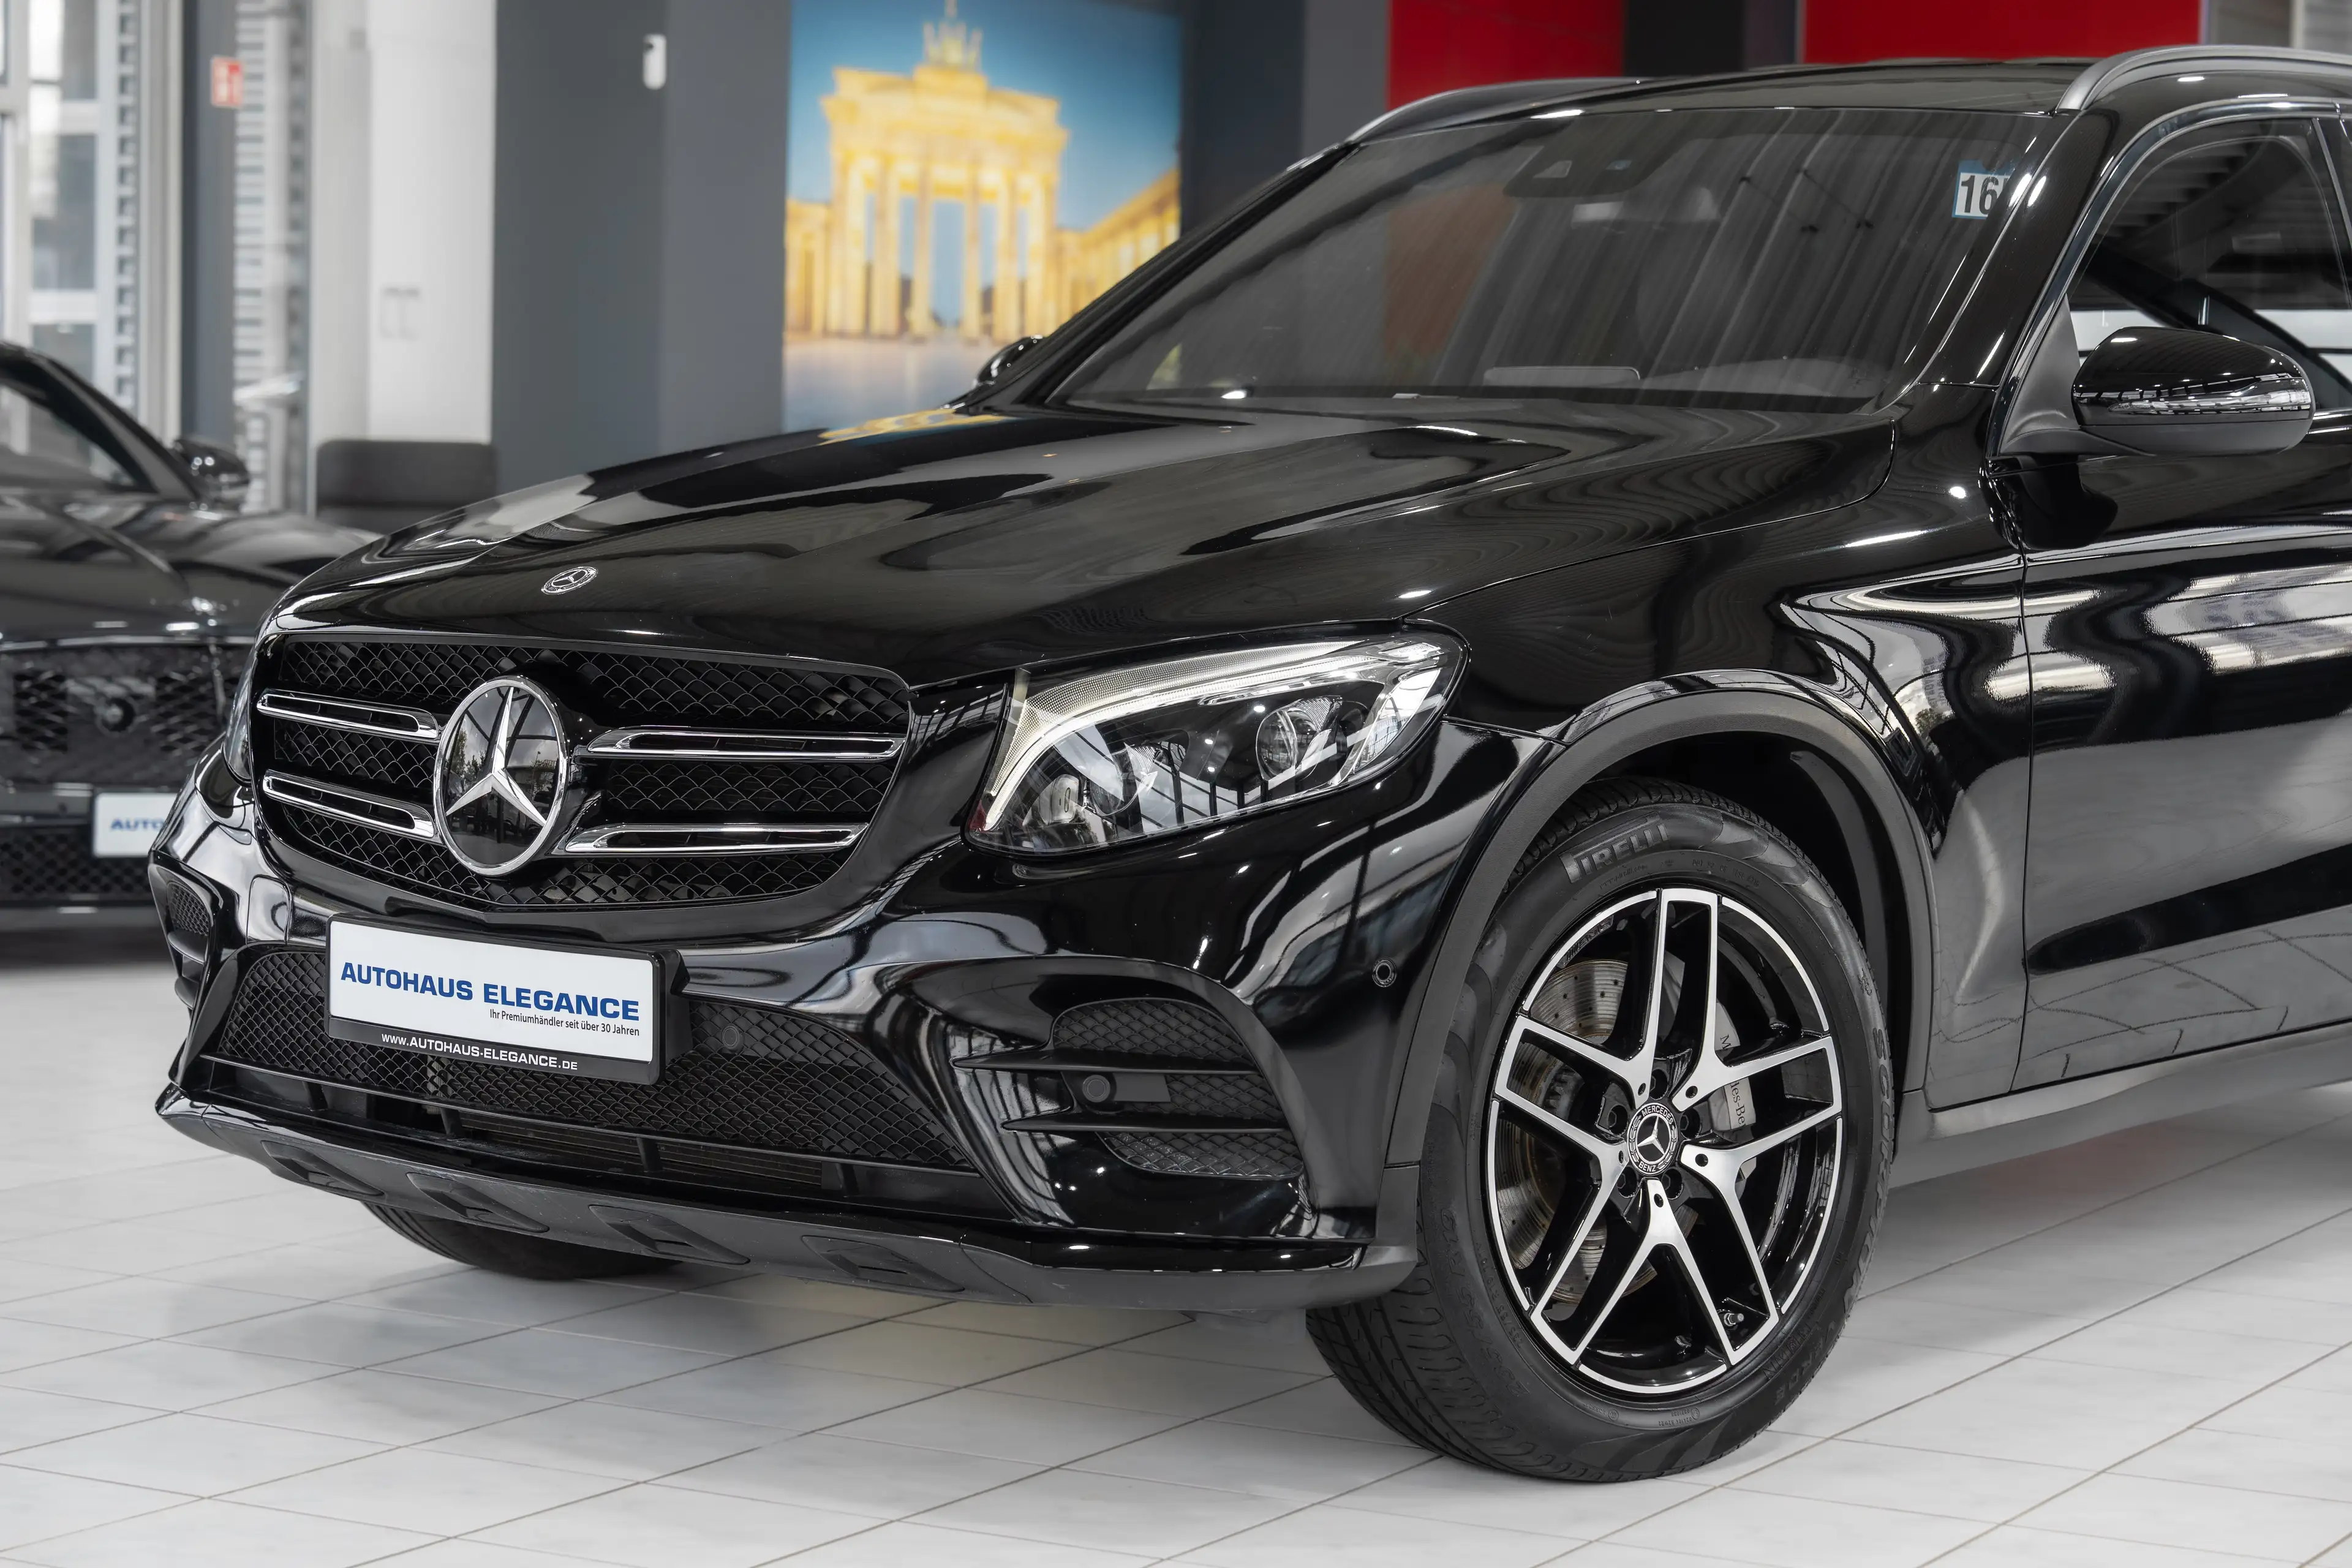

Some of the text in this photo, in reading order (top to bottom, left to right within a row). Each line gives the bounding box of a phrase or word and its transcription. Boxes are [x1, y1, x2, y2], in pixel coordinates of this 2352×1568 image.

[1559, 811, 1670, 884] PIRELLI
[341, 962, 639, 1021] AUTOHAUS ELEGANCE
[490, 1009, 639, 1036] Ihr Premiumhändler seit über 30 Jahren
[1642, 1105, 1674, 1125] MERCEDES
[1638, 1162, 1656, 1172] BENZ
